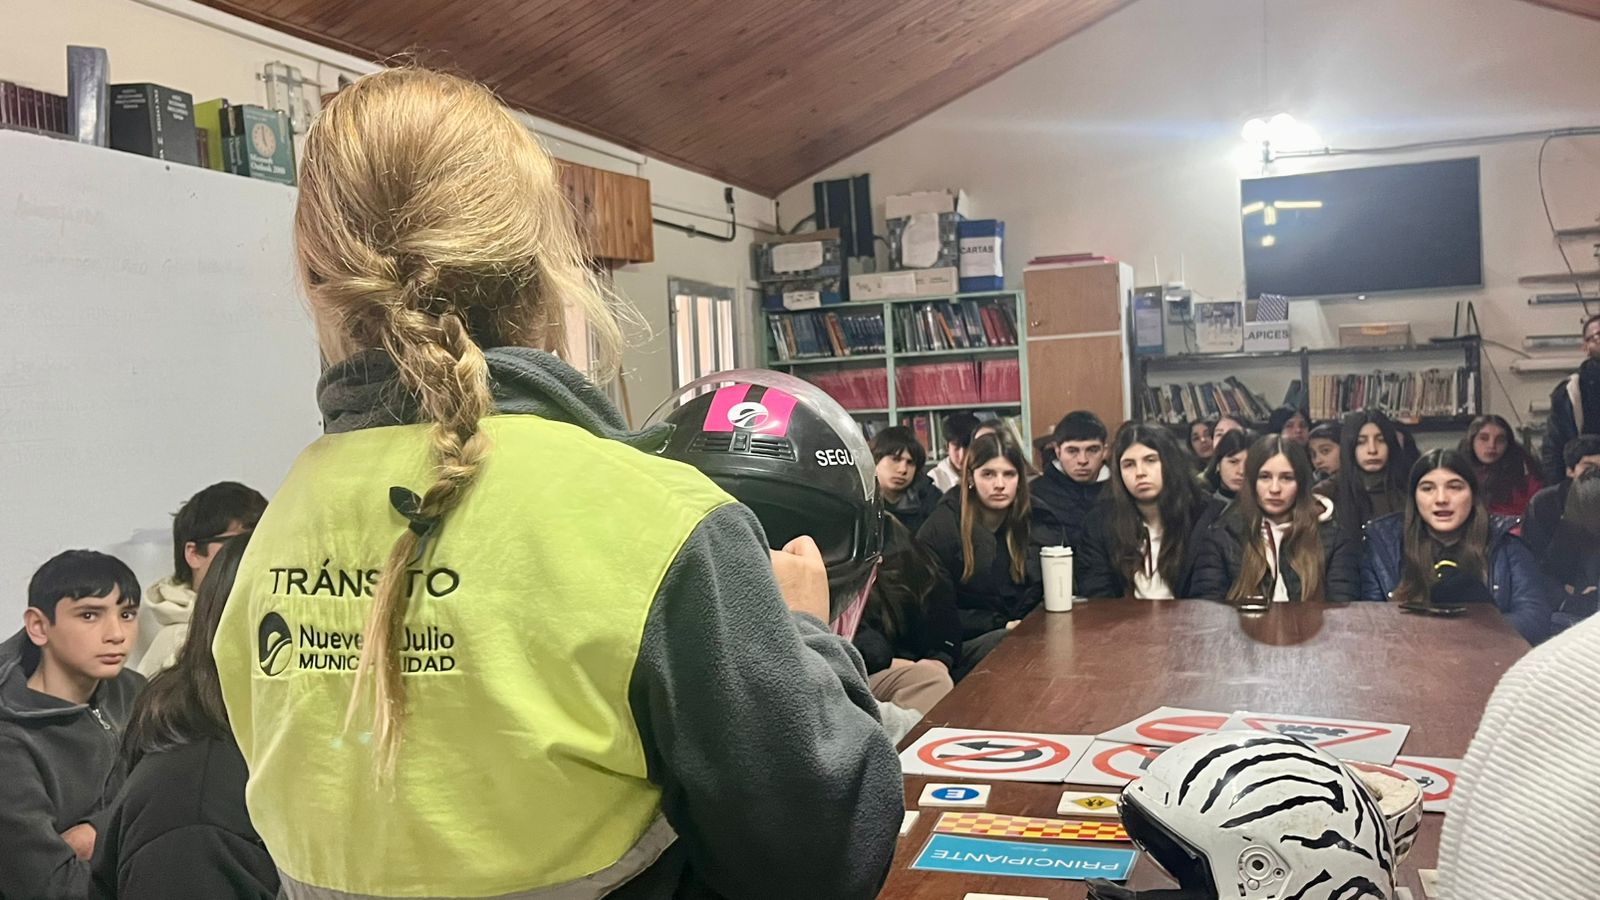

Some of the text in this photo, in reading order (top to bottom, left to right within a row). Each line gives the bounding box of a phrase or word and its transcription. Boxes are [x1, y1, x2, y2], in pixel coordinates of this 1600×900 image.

[960, 245, 994, 254] CARTAS
[1244, 330, 1289, 340] APICES
[270, 558, 459, 597] TRÁNSTO
[300, 625, 454, 651] Nueve Julio
[299, 654, 455, 673] MUNICIDAD
[930, 849, 1119, 870] PRINCIPIANTE
